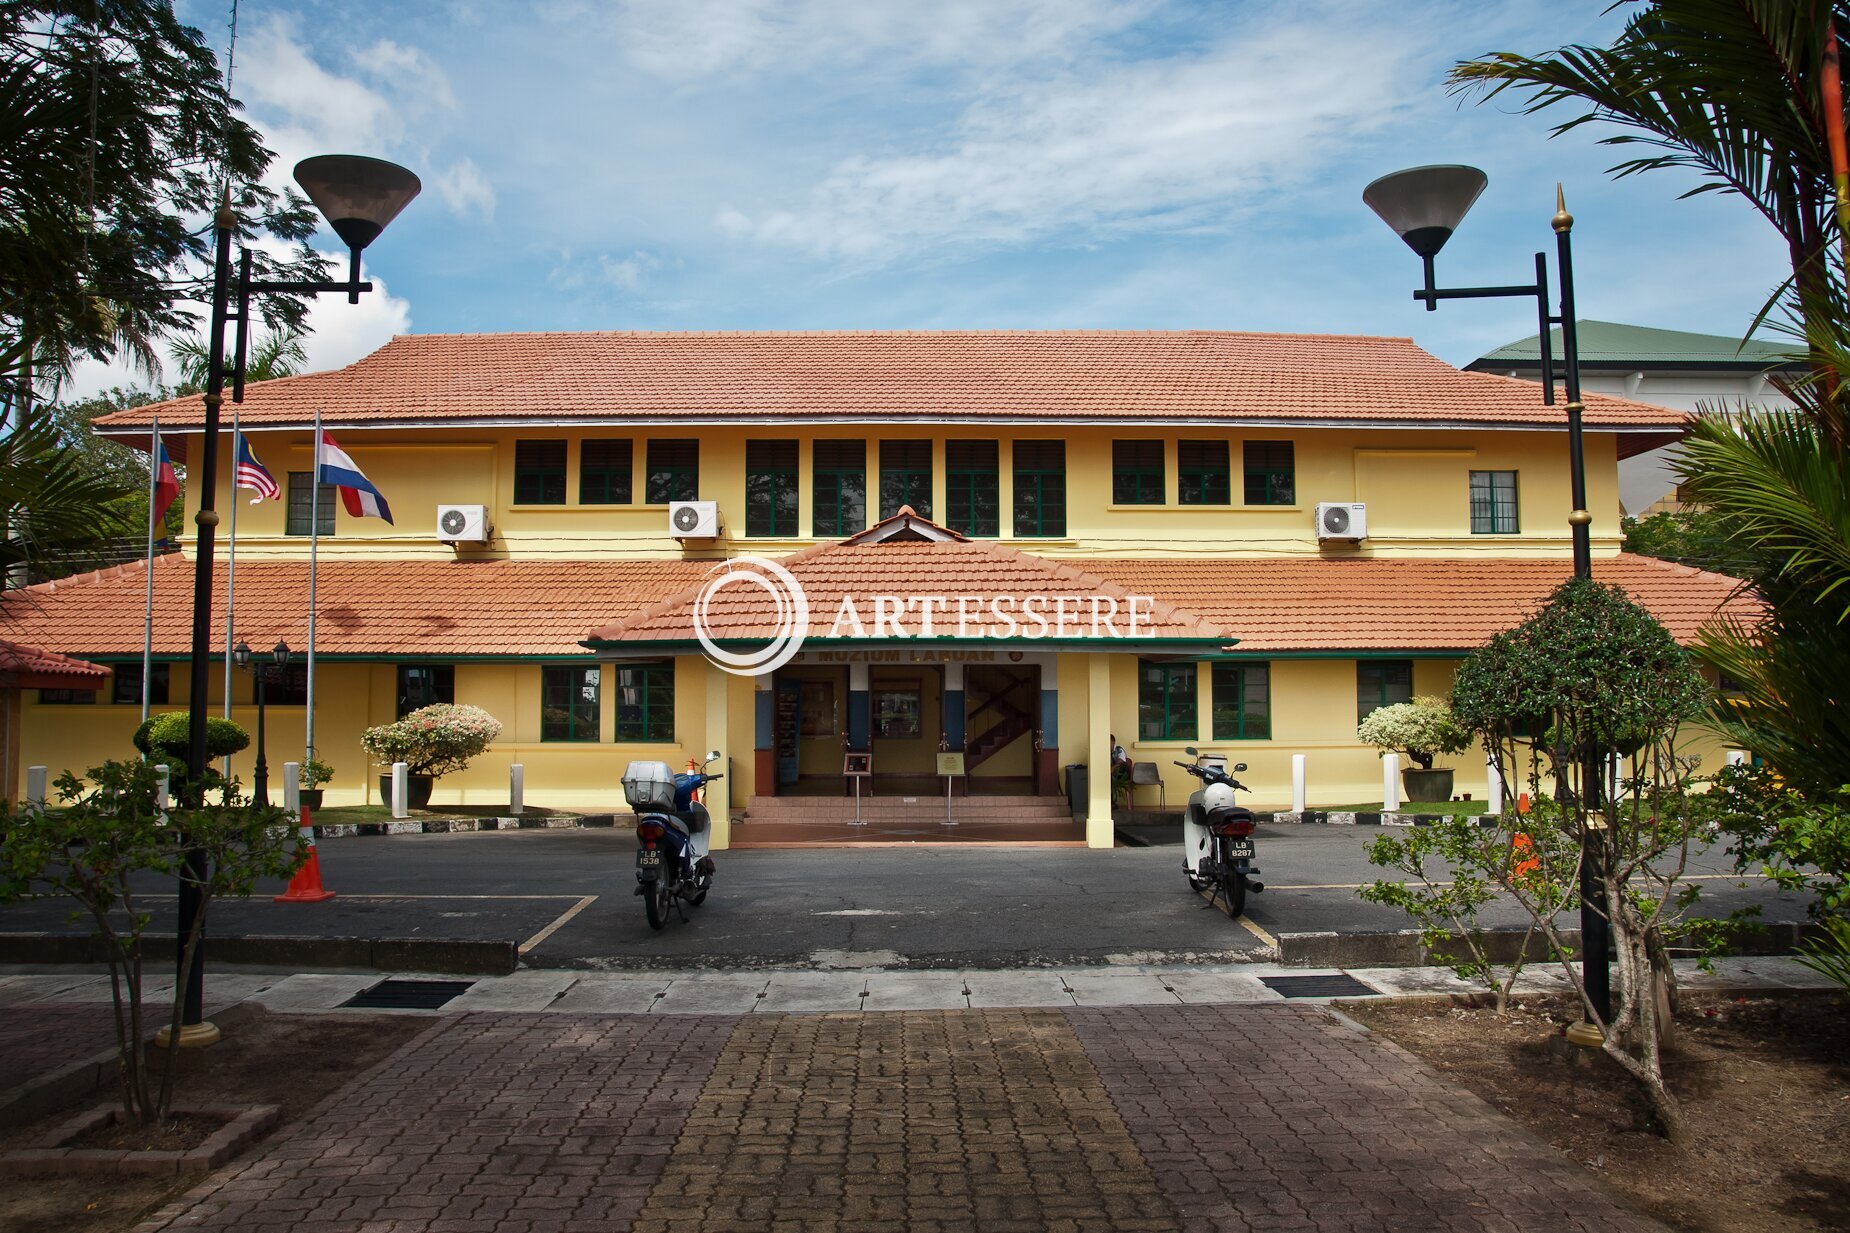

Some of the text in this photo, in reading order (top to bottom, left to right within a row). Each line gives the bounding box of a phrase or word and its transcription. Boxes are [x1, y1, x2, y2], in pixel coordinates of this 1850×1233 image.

[818, 651, 900, 662] MUZIUM
[1235, 841, 1247, 849] LB
[644, 850, 656, 858] LB
[640, 857, 660, 865] 1538
